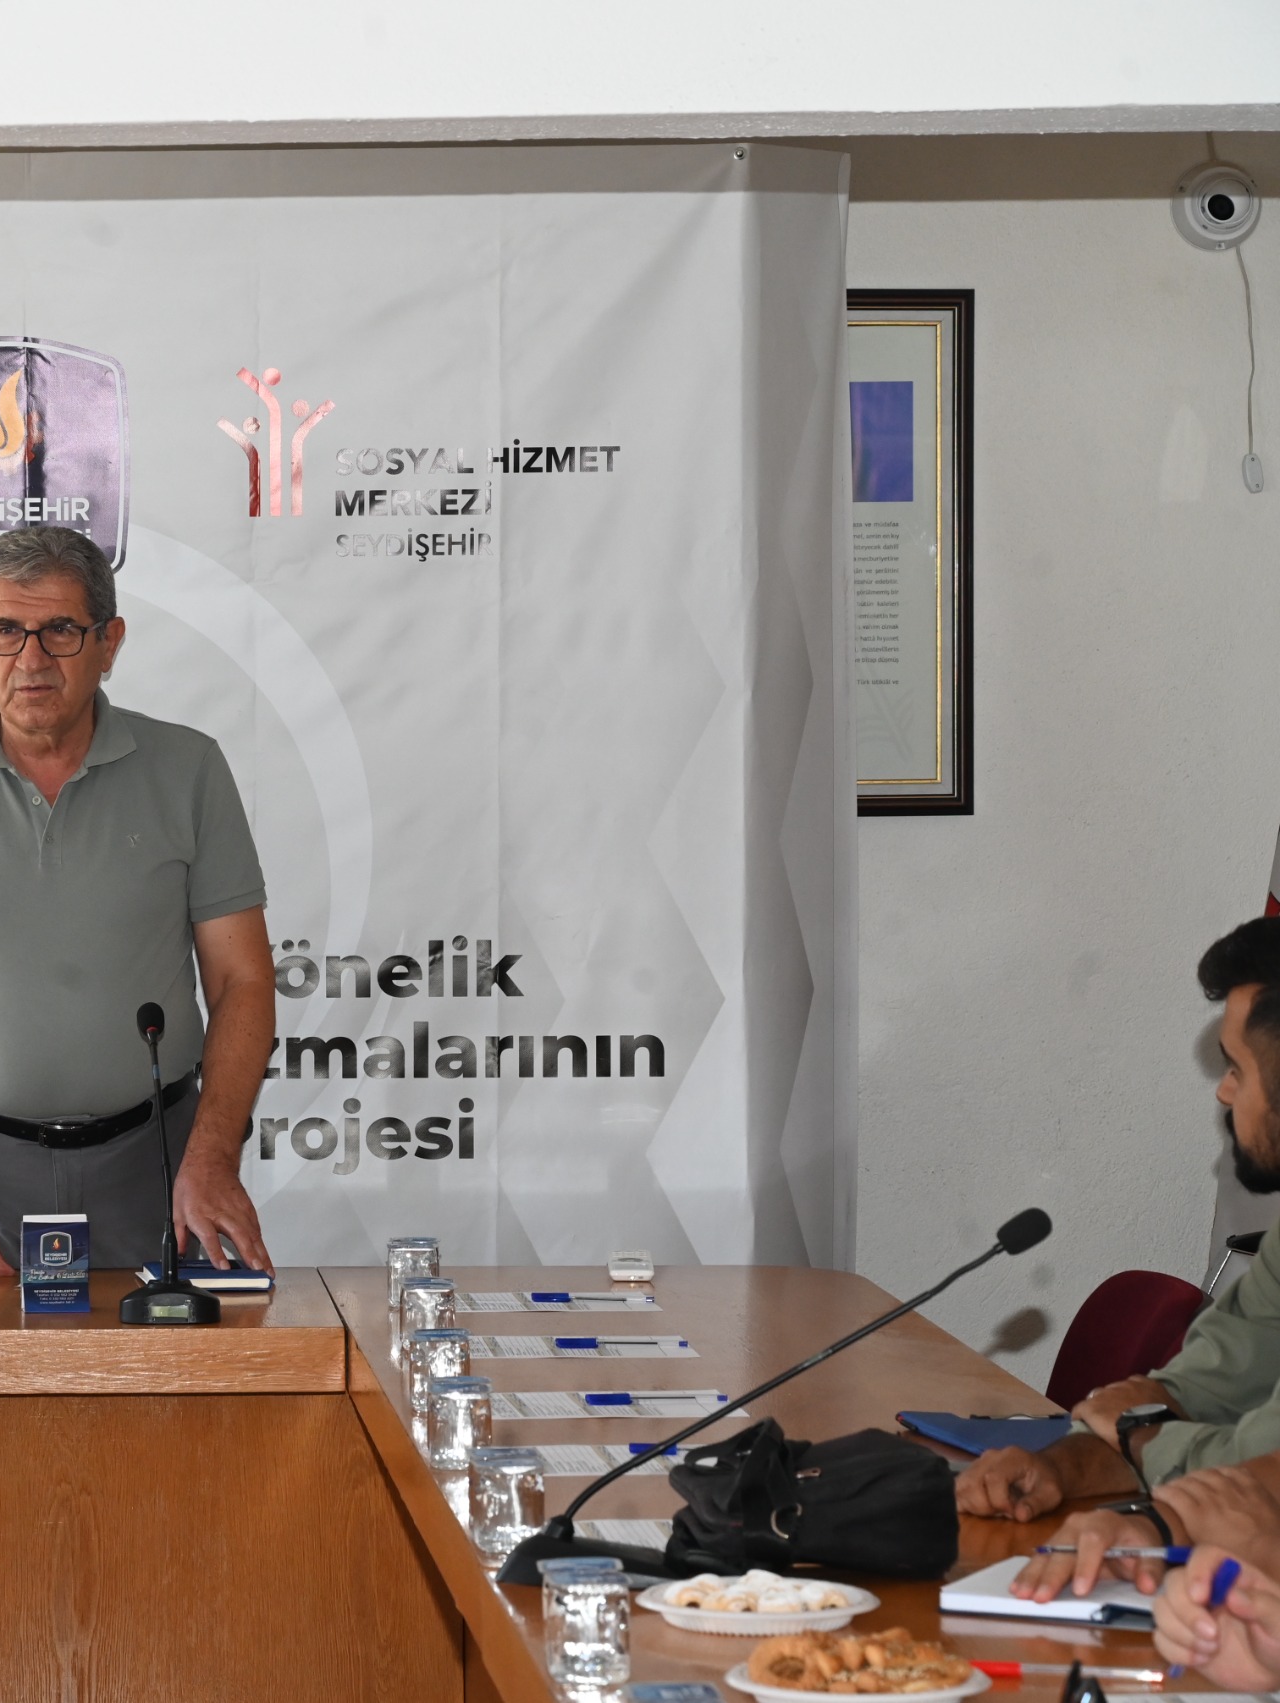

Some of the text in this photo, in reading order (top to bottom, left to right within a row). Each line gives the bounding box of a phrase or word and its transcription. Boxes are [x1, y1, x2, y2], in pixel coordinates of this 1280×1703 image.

[335, 438, 621, 477] SOSYAL HİZMET
[335, 480, 493, 518] MERKEZİ
[335, 527, 495, 562] SEYDİŞEHİR
[269, 934, 524, 999] önelik
[242, 1097, 476, 1176] rojesi
